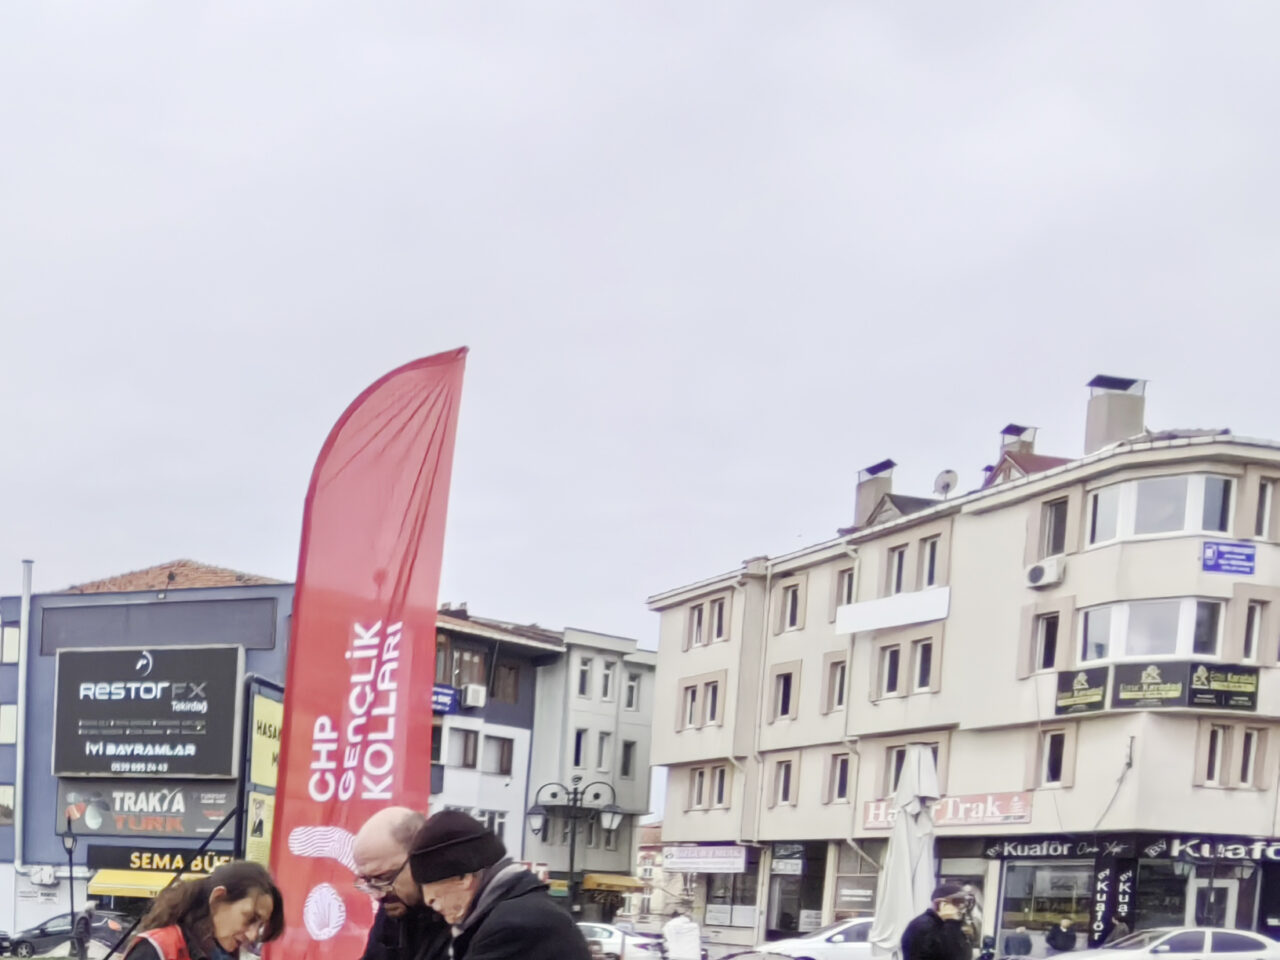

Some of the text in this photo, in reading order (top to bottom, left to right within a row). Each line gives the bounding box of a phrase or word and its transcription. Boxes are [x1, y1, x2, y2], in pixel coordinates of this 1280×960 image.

[171, 701, 207, 714] Tekirdağ
[361, 620, 403, 800] KOLLARI
[105, 743, 196, 757] BAYRAMLAR
[308, 715, 338, 802] CHP
[112, 788, 185, 813] TRAKYA
[947, 795, 1002, 820] Trak
[1003, 840, 1073, 857] Kuaför
[130, 851, 184, 870] SEMA
